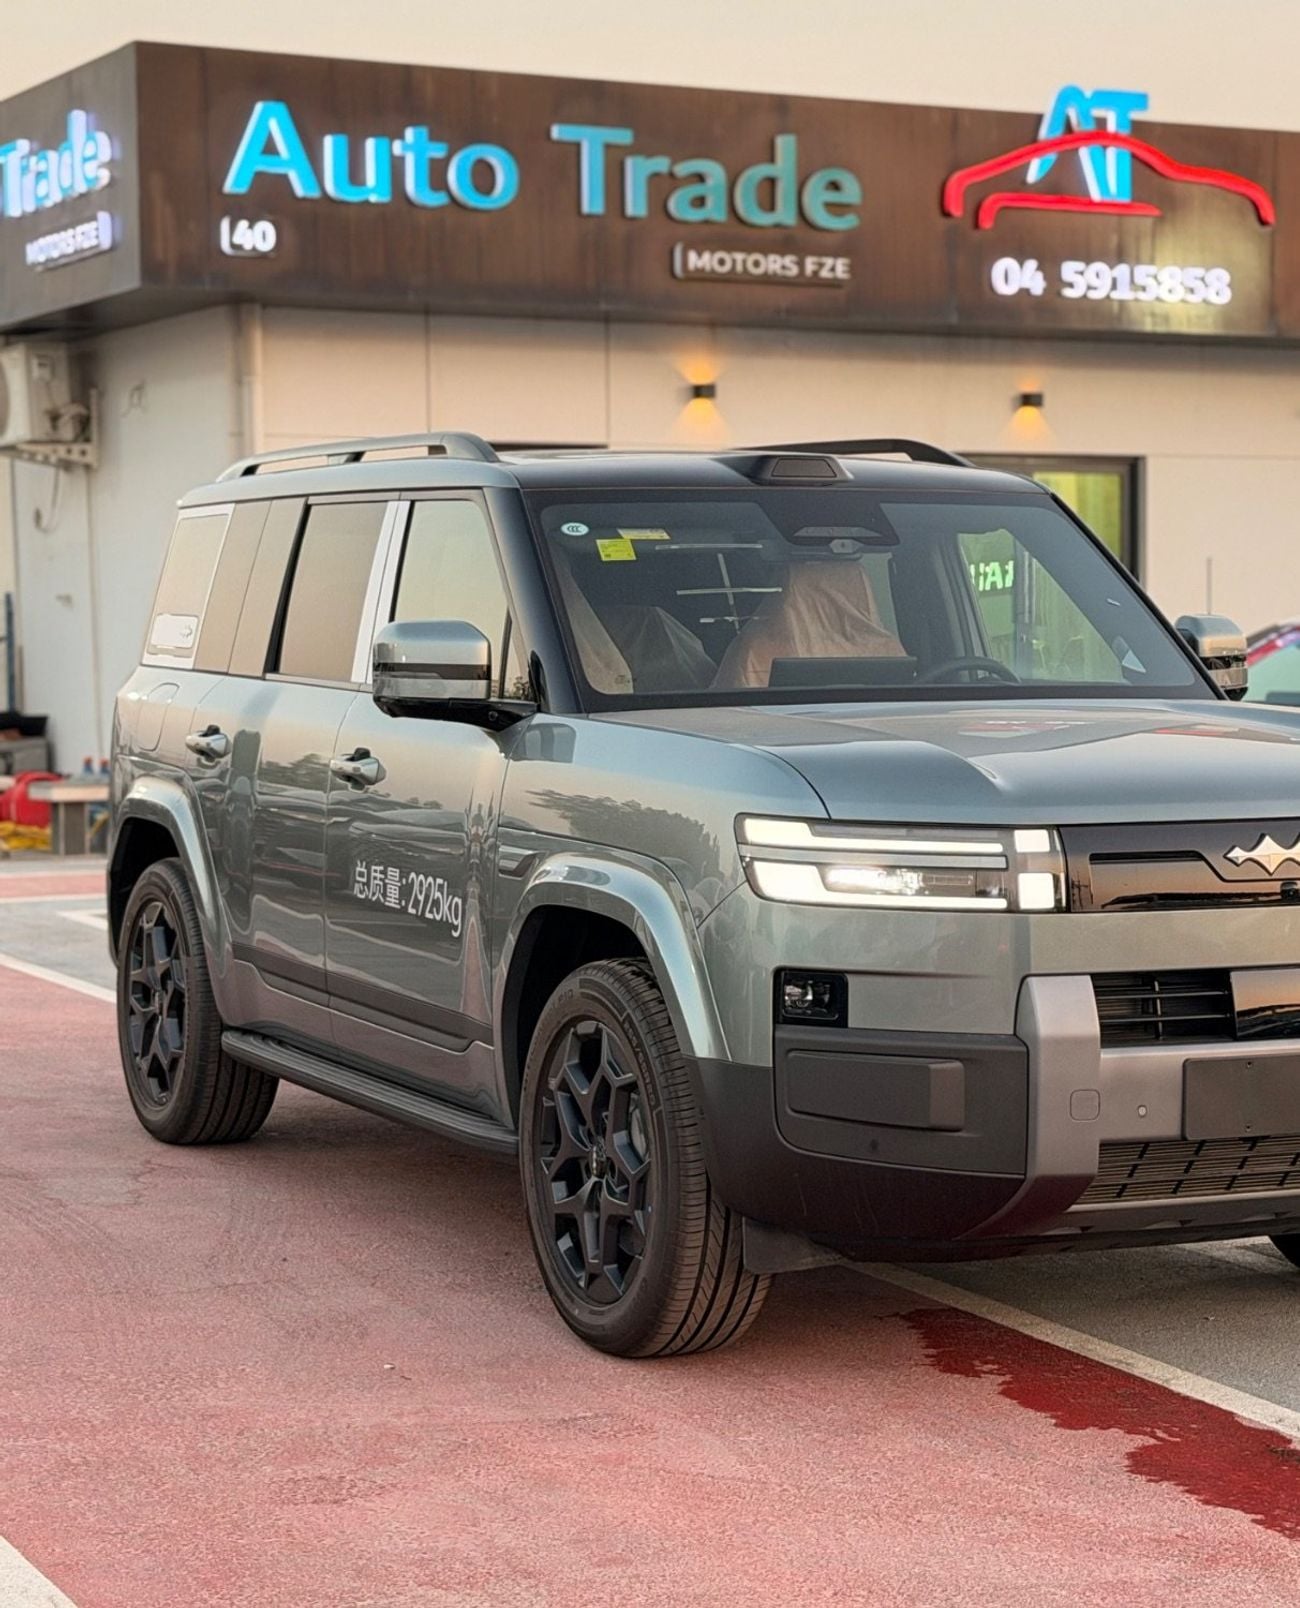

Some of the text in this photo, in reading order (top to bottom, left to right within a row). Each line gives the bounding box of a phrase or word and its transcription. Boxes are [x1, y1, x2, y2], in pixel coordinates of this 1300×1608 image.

[0, 109, 112, 217] Trade
[222, 99, 862, 231] Auto Trade
[1026, 85, 1149, 202] AT
[687, 249, 851, 280] MOTORS FZE
[991, 257, 1233, 305] 04 5915858
